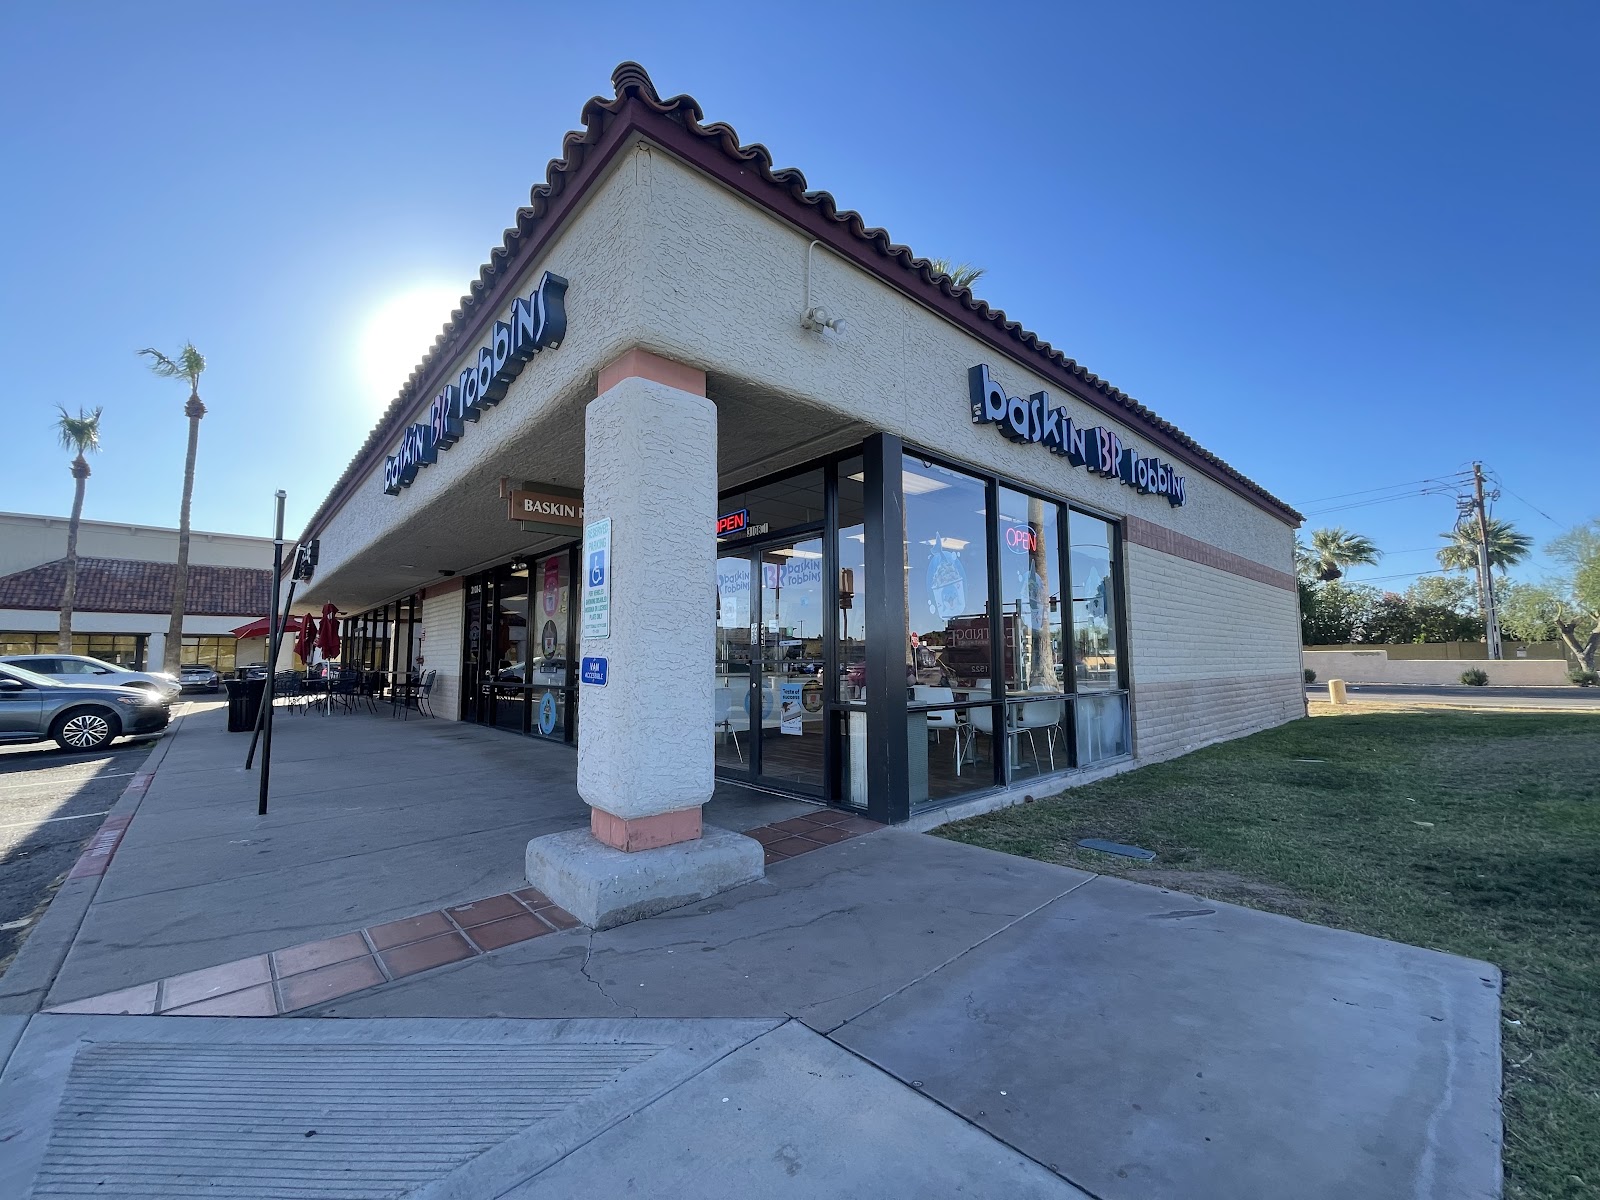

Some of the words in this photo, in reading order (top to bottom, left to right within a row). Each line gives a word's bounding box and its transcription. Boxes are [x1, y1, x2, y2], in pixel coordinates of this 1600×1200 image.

[976, 364, 1086, 465] baskin
[1093, 426, 1123, 478] BR
[1129, 448, 1187, 507] robbins
[524, 498, 575, 518] BASKIN
[587, 523, 609, 539] RESERVED
[588, 537, 607, 551] PARKING
[1006, 527, 1037, 552] OPEN
[787, 559, 820, 574] baskin
[724, 570, 750, 583] baskin
[788, 571, 821, 586] robbins
[724, 581, 750, 594] robbins
[589, 662, 600, 672] VAN
